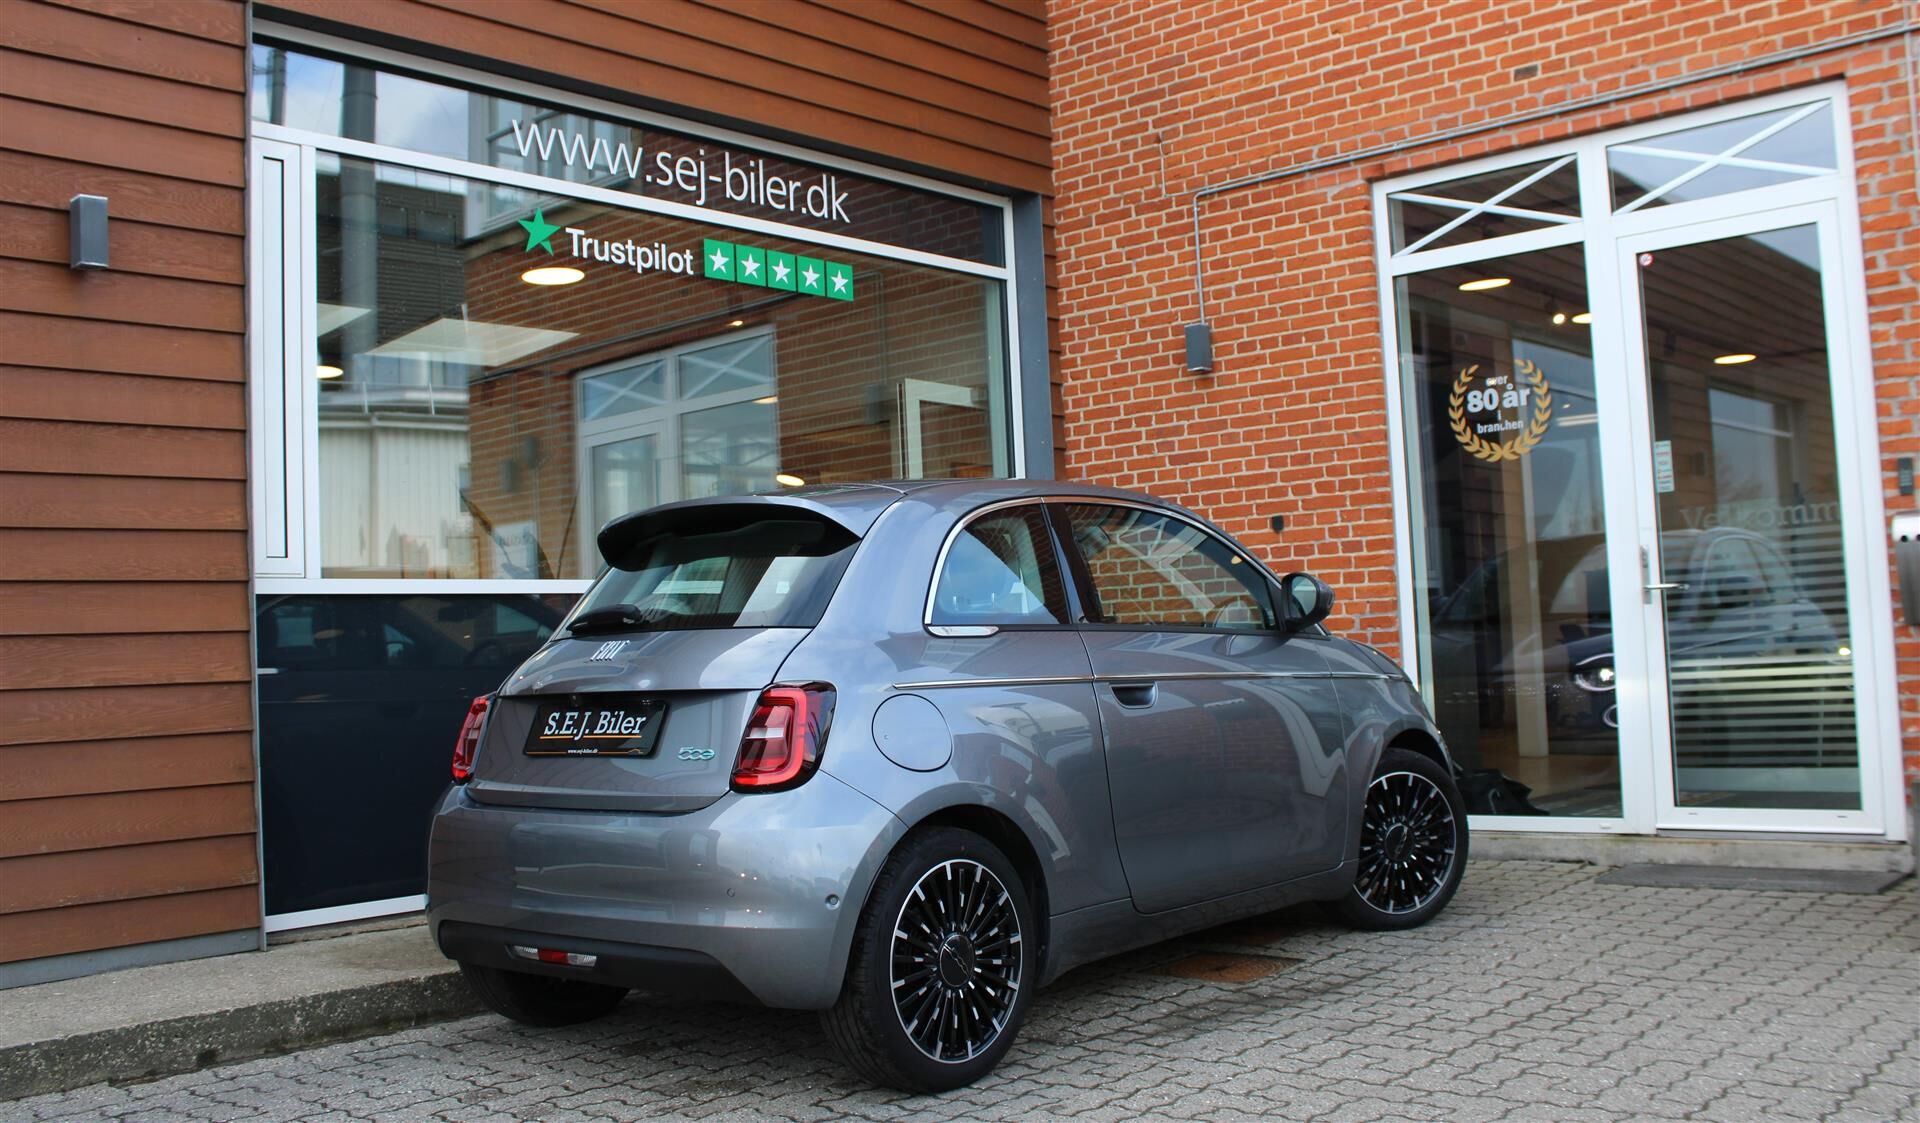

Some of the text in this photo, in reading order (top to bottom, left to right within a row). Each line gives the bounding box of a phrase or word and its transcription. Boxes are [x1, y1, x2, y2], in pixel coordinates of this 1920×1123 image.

[511, 119, 851, 223] www.sej-biler.dk
[565, 227, 694, 274] Trustpilot
[1466, 383, 1531, 413] 80 år
[543, 710, 646, 741] S.E.J. Biler
